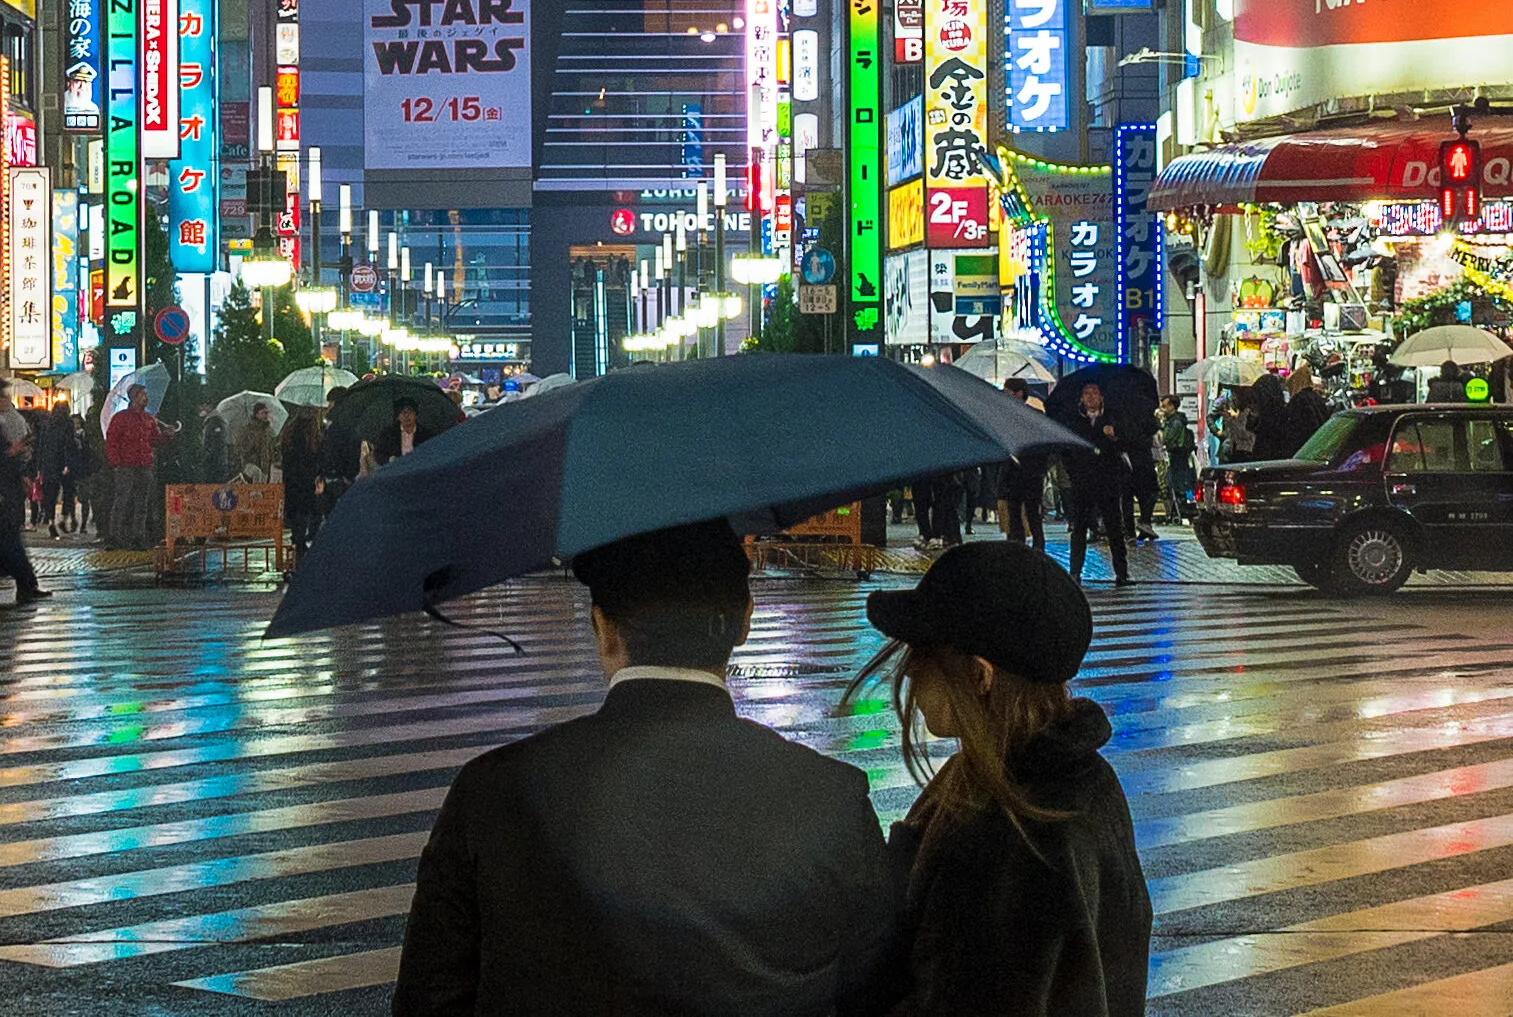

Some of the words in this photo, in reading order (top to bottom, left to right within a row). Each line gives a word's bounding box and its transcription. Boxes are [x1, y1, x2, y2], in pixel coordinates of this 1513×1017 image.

[371, 37, 525, 76] WARS
[179, 13, 205, 245] カラオケ館
[400, 96, 481, 123] 12/15
[929, 57, 986, 181] 金の蔵
[110, 159, 134, 265] ROAD
[930, 191, 969, 224] 2F
[1070, 221, 1102, 339] カラオケ
[1125, 288, 1155, 310] B1
